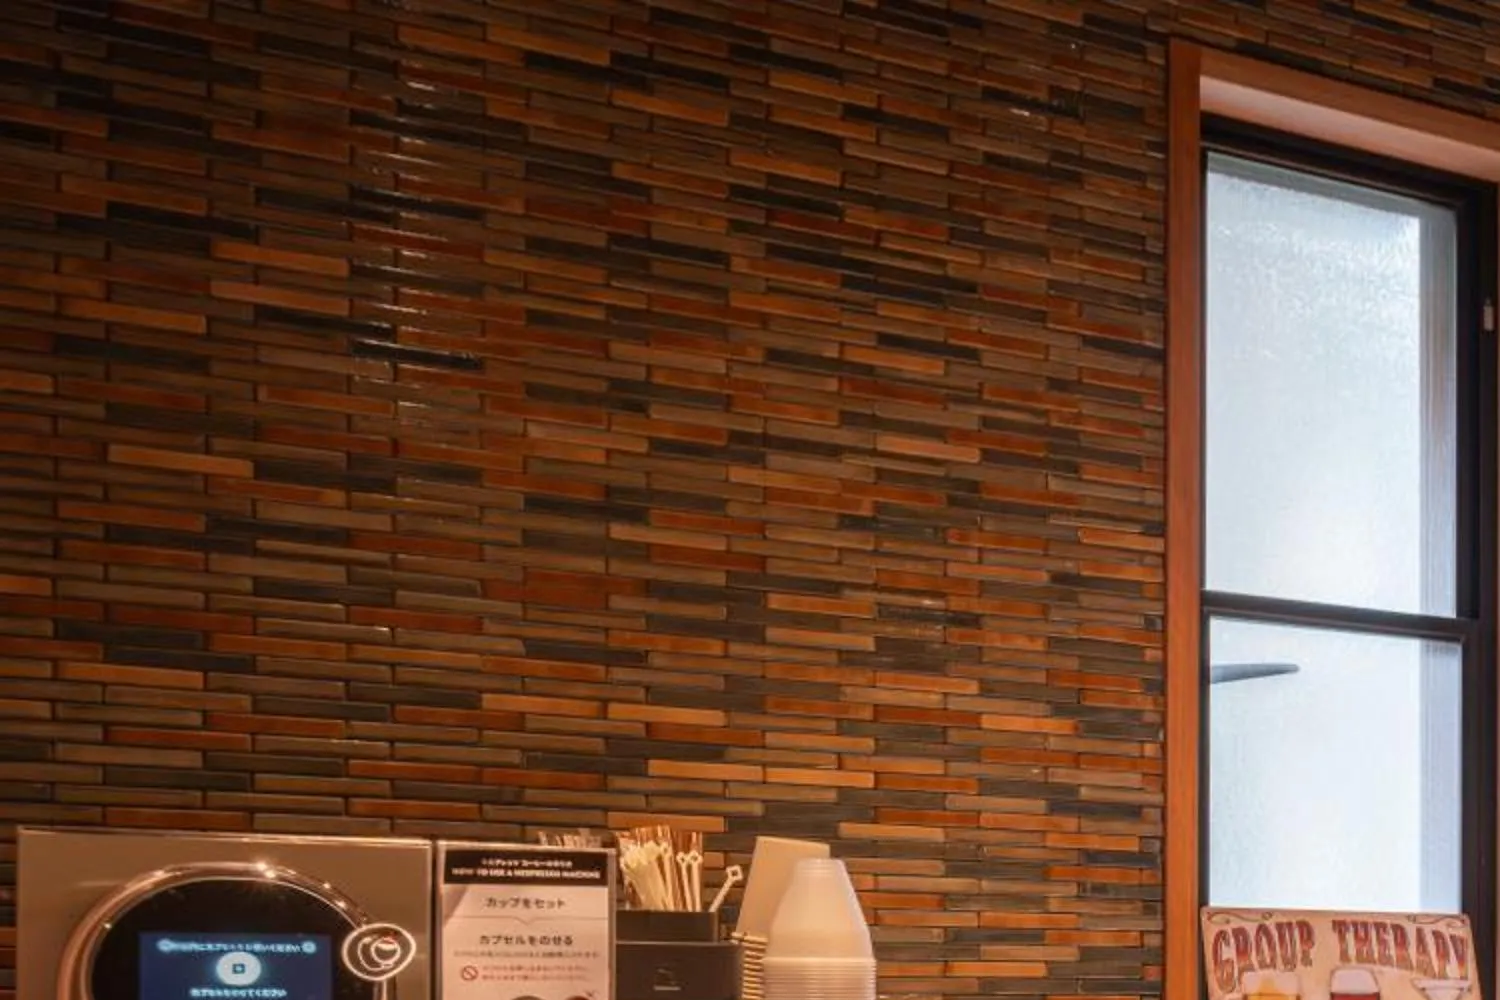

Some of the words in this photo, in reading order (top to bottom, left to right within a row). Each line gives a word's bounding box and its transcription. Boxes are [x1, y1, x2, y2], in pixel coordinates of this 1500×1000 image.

[485, 896, 566, 911] カップをセット
[479, 935, 574, 946] カプセルをのせる
[1212, 919, 1315, 993] GROUP
[1332, 919, 1469, 980] THERAPY
